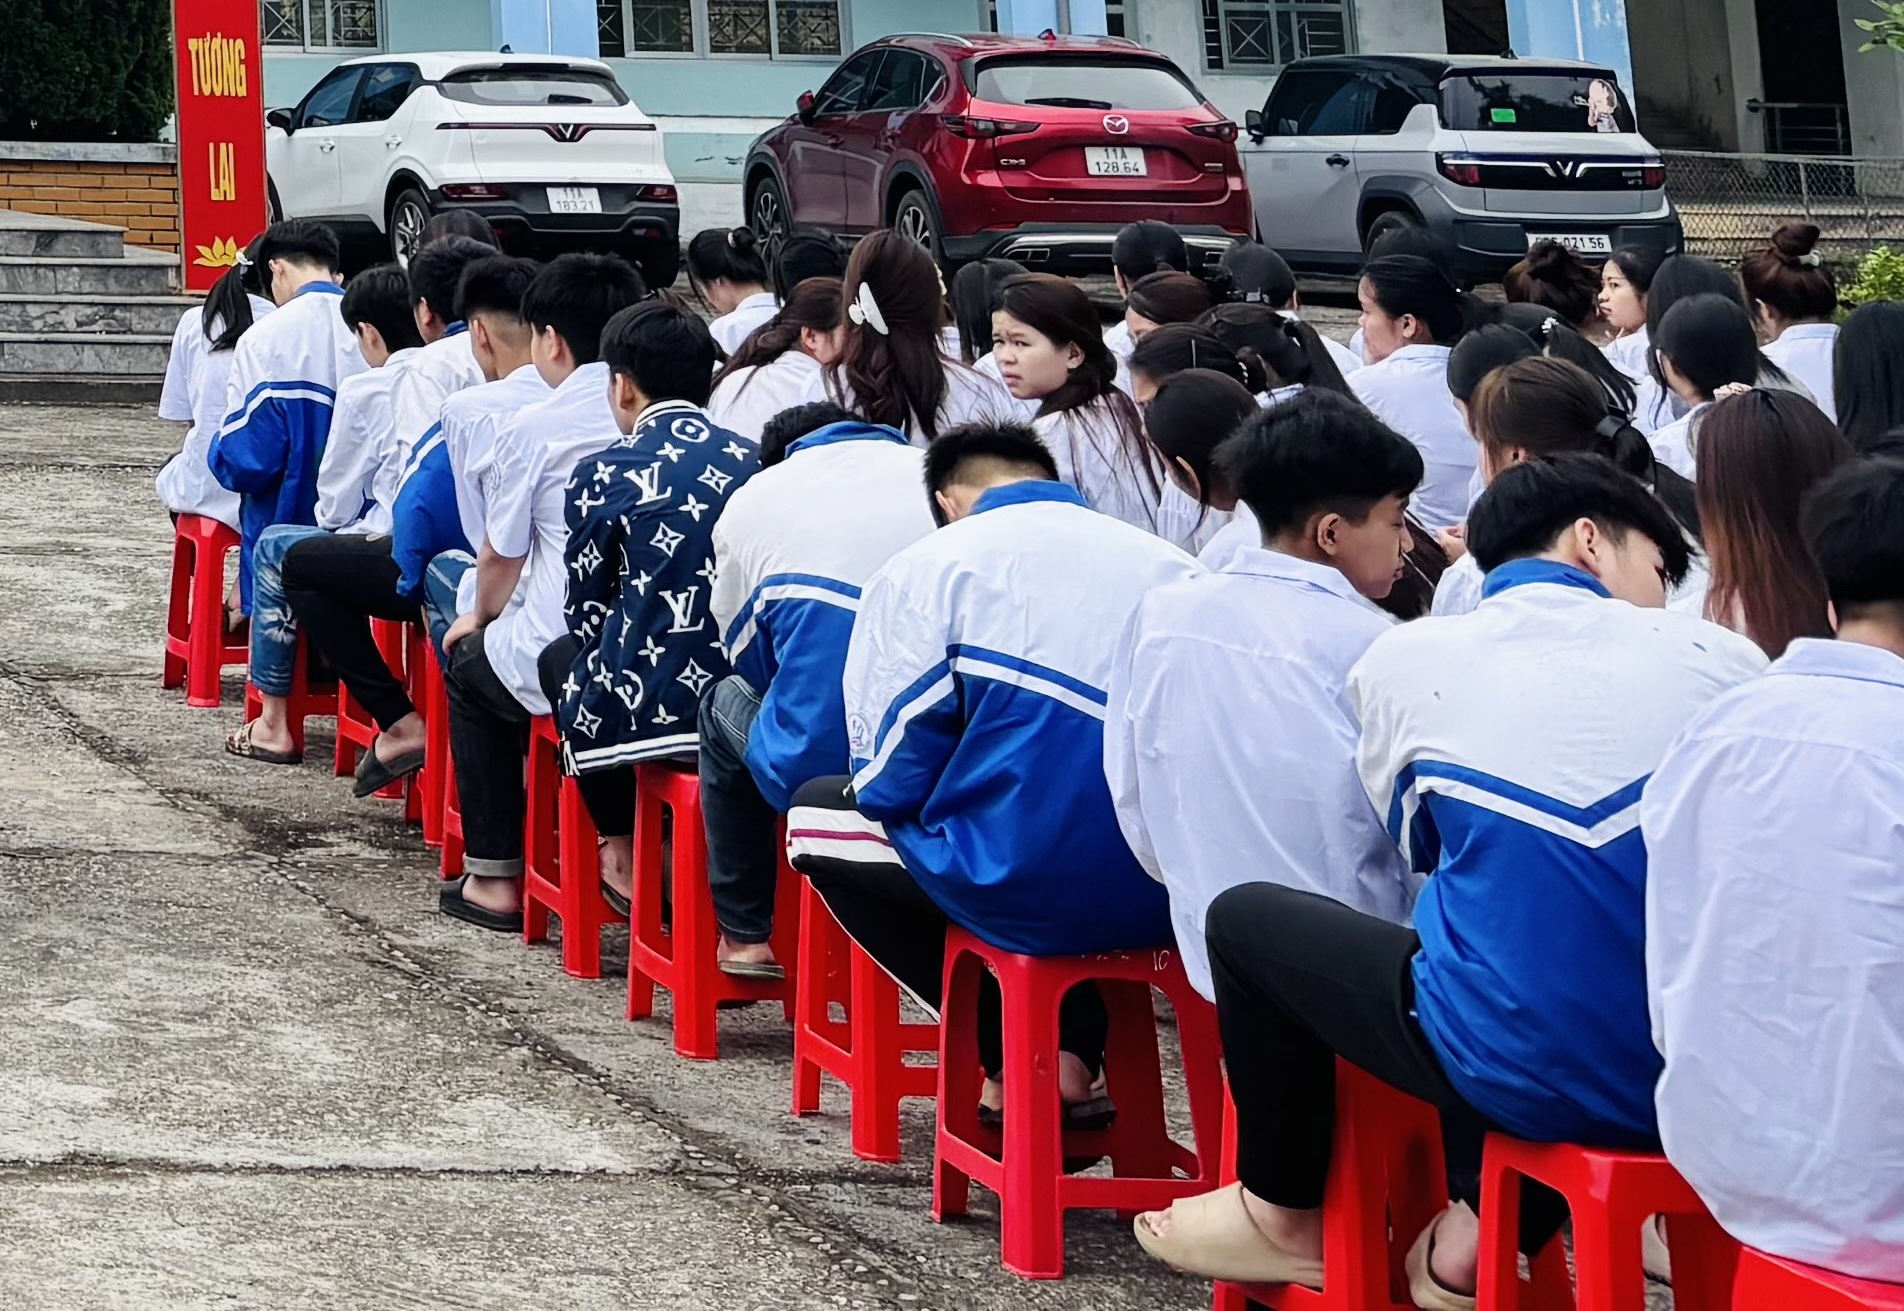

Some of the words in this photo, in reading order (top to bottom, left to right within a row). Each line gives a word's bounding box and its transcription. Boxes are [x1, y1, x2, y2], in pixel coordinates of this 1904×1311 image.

[187, 31, 248, 98] TƯƠNG
[1103, 147, 1128, 160] 11A
[208, 141, 236, 202] LAI
[1095, 161, 1141, 174] 128.64
[562, 186, 585, 199] 11A
